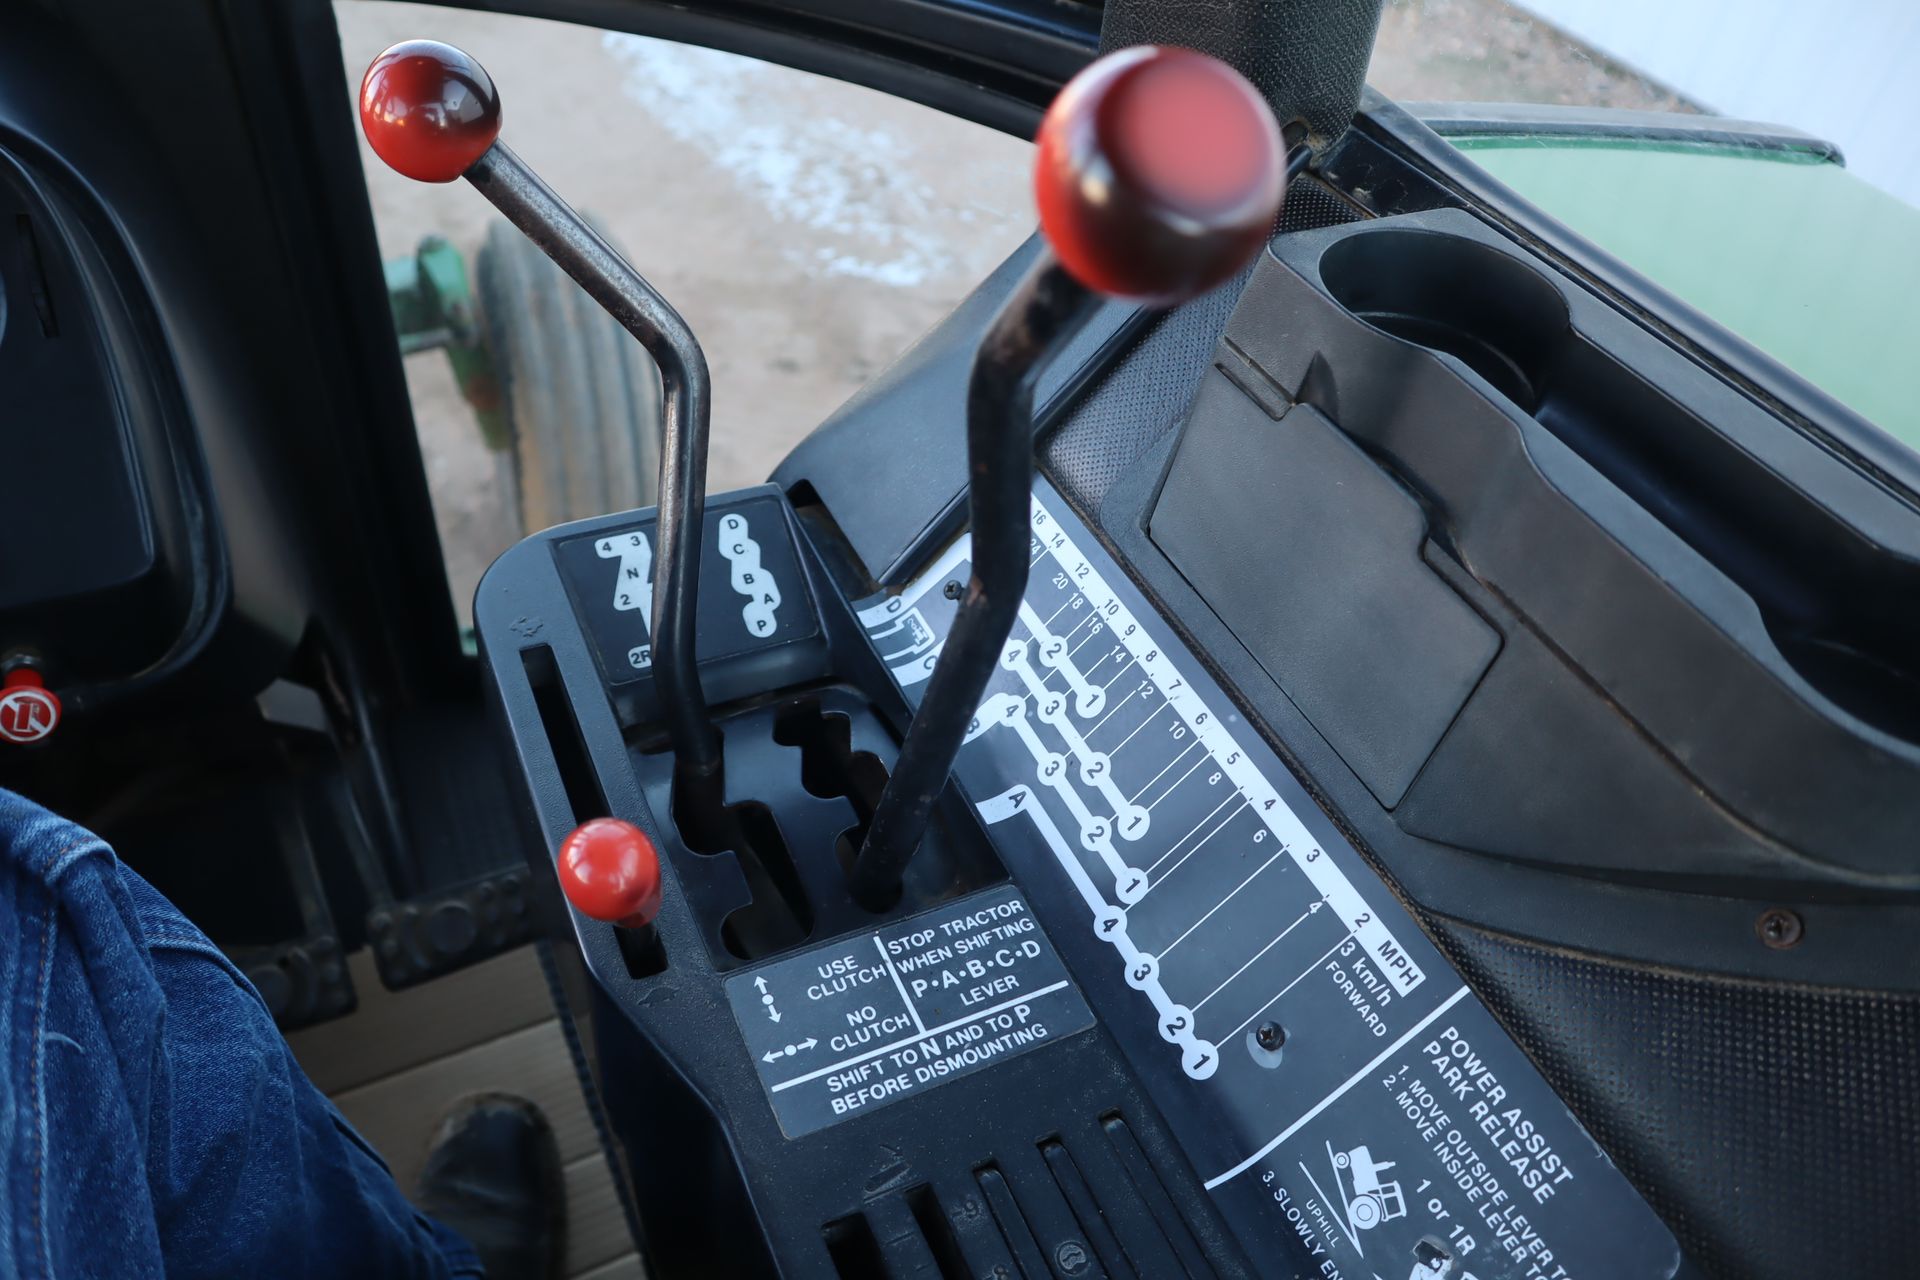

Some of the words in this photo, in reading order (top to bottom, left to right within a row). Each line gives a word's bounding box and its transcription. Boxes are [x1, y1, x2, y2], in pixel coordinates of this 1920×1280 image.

[727, 518, 739, 529] D
[1033, 510, 1046, 525] 16
[602, 542, 612, 552] 4
[630, 535, 641, 546] 3
[733, 543, 745, 555] C
[1051, 532, 1065, 549] 14
[626, 567, 639, 579] N
[743, 573, 754, 585] B
[1075, 563, 1089, 579] 12
[1052, 572, 1068, 590] 20
[620, 594, 631, 605] 2
[763, 593, 775, 604] A
[886, 598, 901, 613] D
[1069, 592, 1084, 609] 18
[1104, 599, 1119, 615] 10
[756, 619, 767, 631] P
[1088, 617, 1103, 634] 16
[1124, 624, 1136, 636] 9
[1007, 649, 1021, 663] 4
[1046, 643, 1062, 659] 2
[1110, 645, 1127, 663] 14
[1145, 650, 1158, 662] 8
[923, 655, 937, 670] C
[1137, 680, 1154, 699] 12
[1168, 679, 1182, 691] 7
[1045, 700, 1060, 716] 3
[1086, 694, 1099, 708] 1
[1006, 704, 1019, 718] 4
[1195, 712, 1208, 725] 6
[1168, 720, 1186, 740] 10
[1226, 752, 1240, 765] 5
[1045, 761, 1060, 777] 3
[1086, 761, 1104, 779] 2
[1208, 771, 1222, 785] 8
[1008, 791, 1026, 808] A
[1264, 798, 1277, 811] 4
[1127, 816, 1142, 831] 1
[1087, 825, 1105, 843] 2
[1253, 829, 1267, 843] 6
[1306, 848, 1320, 863] 3
[1125, 878, 1141, 894] 1
[1309, 901, 1324, 915] 4
[887, 929, 935, 955] STOP
[940, 900, 1024, 937] TRACTOR
[1103, 918, 1119, 933] 4
[1354, 912, 1371, 928] 2
[896, 946, 953, 974] WHEN
[954, 918, 1035, 954] SHIFTING
[818, 955, 859, 979] USE
[1377, 939, 1419, 986] MPH
[1134, 963, 1151, 981] 3
[1340, 942, 1356, 957] 3
[1352, 957, 1391, 1007] km/h
[807, 964, 887, 1000] CLUTCH
[960, 975, 1020, 1006] LEVER
[1325, 961, 1387, 1037] FORWARD
[846, 1006, 877, 1026] NO
[830, 1013, 911, 1052] CLUTCH
[1166, 1016, 1186, 1036] 2
[827, 1059, 883, 1092] SHIFT
[890, 1049, 918, 1068] TO
[919, 1037, 942, 1060] N
[944, 1024, 984, 1051] AND
[985, 1014, 1013, 1033] TO
[1014, 1004, 1031, 1024] P
[831, 1073, 913, 1115] BEFORE
[915, 1023, 1048, 1083] DISMOUNTING
[1193, 1053, 1210, 1070] 1
[1440, 1026, 1507, 1106] POWER
[1502, 1108, 1574, 1185] ASSIST
[1422, 1041, 1475, 1101] PARK
[1469, 1100, 1555, 1204] RELEASE
[1383, 1074, 1396, 1092] 2.
[1396, 1091, 1438, 1142] MOVE
[1433, 1142, 1483, 1202] INSIDE
[1478, 1202, 1528, 1263] LEVER
[1398, 1064, 1409, 1081] 1.
[1409, 1079, 1451, 1130] MOVE
[1447, 1130, 1508, 1206] OUTSIDE
[1503, 1205, 1553, 1266] LEVER
[1262, 1170, 1275, 1187] 3.
[1274, 1188, 1325, 1256] SLOWLY
[1416, 1179, 1432, 1193] 1
[1428, 1198, 1450, 1220] or
[1449, 1224, 1476, 1256] 1R
[1306, 1199, 1340, 1248] UPHILL
